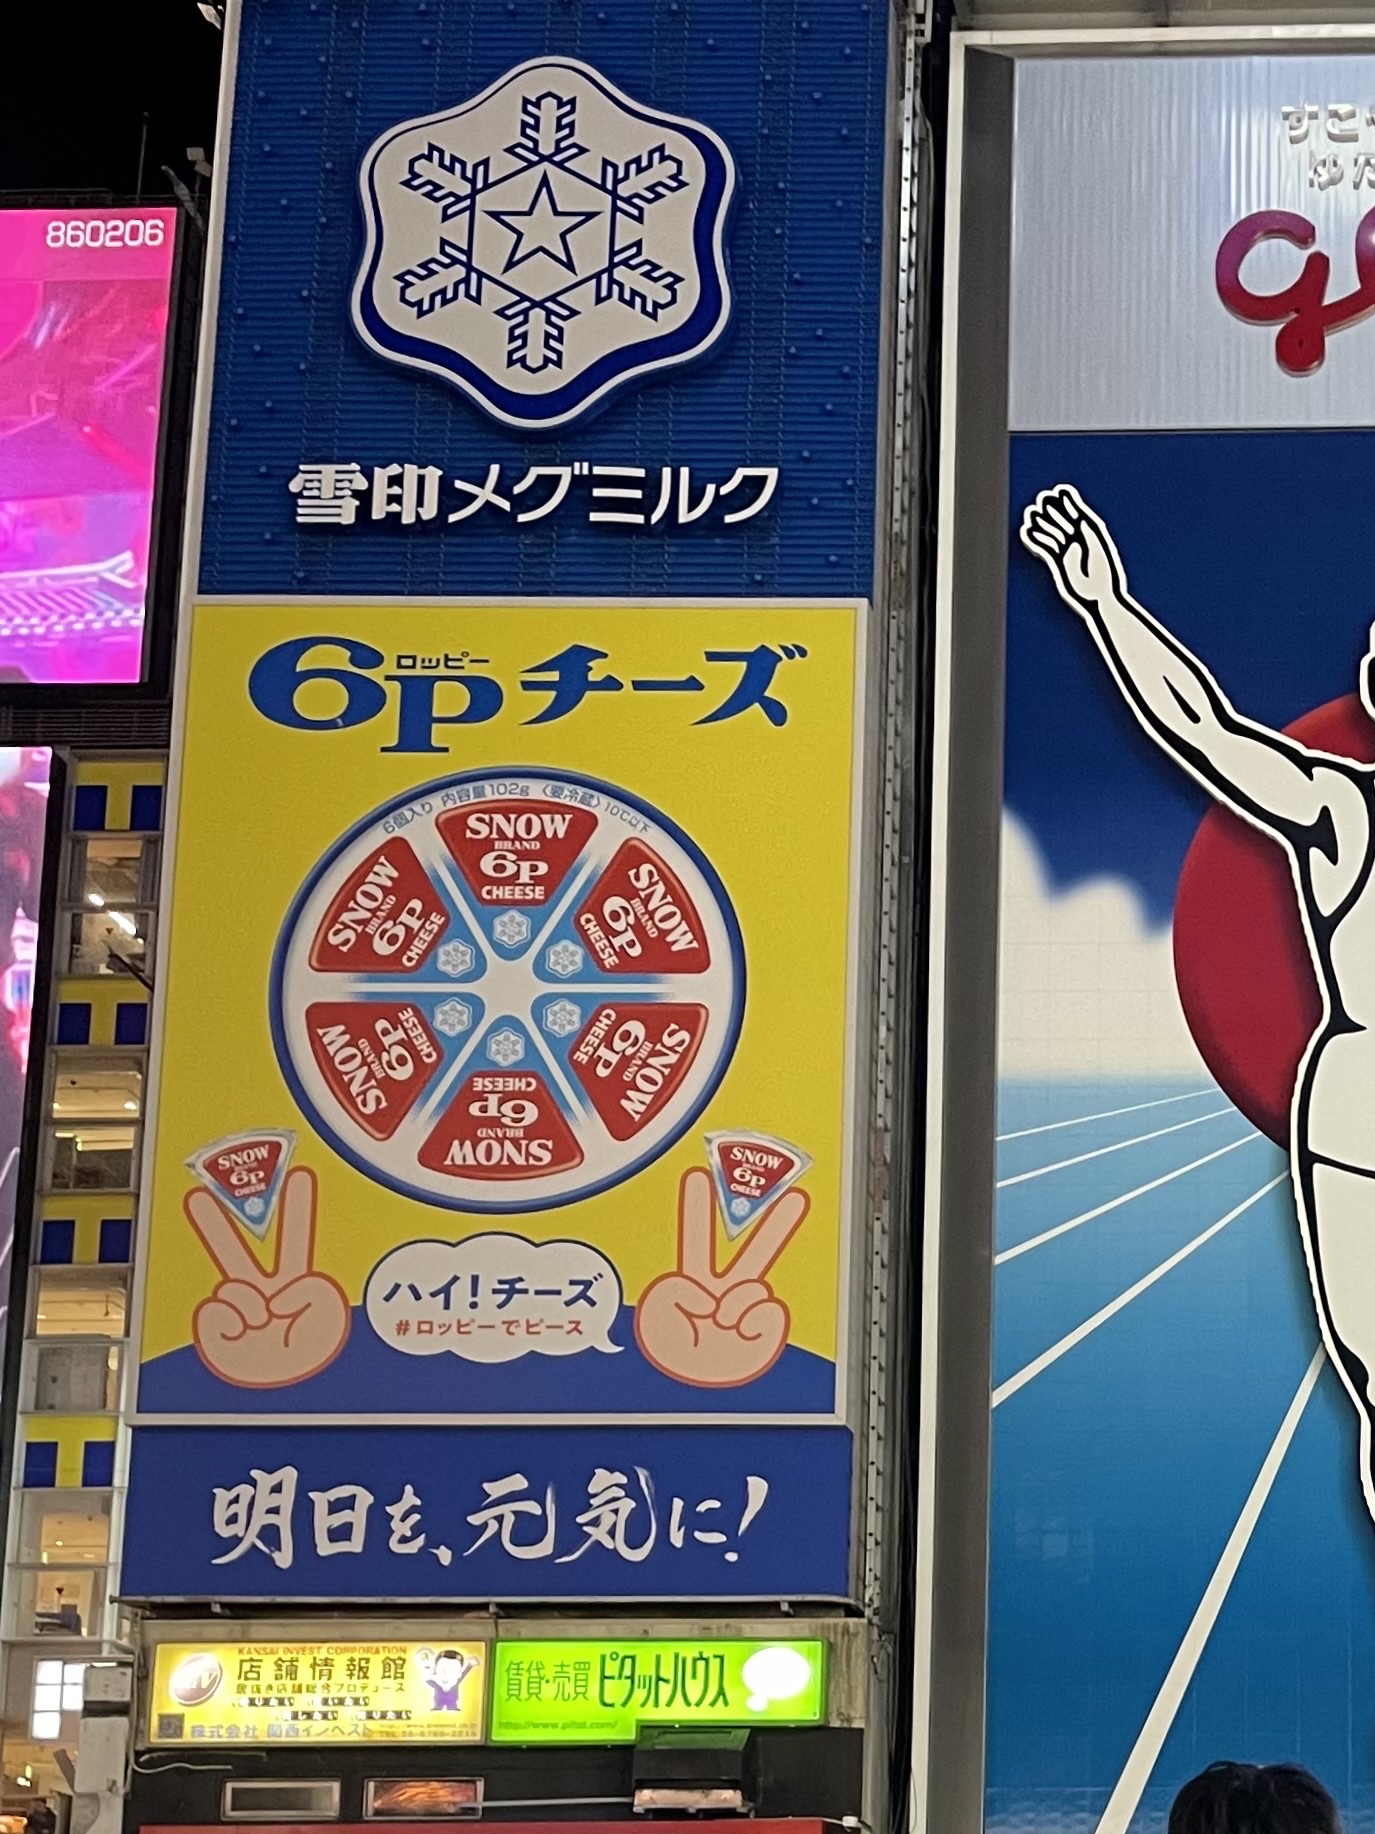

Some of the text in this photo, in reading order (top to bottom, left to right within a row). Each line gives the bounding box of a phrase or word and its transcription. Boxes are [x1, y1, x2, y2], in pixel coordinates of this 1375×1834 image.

[45, 219, 164, 248] 860206
[288, 462, 779, 526] 雪印メグミルク
[397, 652, 490, 669] ロッピー
[465, 813, 573, 839] SNOW
[494, 840, 541, 851] BRAND
[327, 855, 400, 953] SNOW
[481, 886, 545, 900] CHEESE
[628, 862, 699, 953] SNOW
[366, 894, 396, 936] BRAND
[630, 898, 658, 938] BRAND
[402, 911, 445, 968] CHEESE
[579, 912, 619, 970] CHEESE
[398, 1007, 438, 1064] CHEESE
[573, 1008, 616, 1064] CHEESE
[316, 1023, 388, 1116] SNOW
[473, 1077, 537, 1091] CHEESE
[620, 1023, 691, 1122] SNOW
[443, 1138, 553, 1166] SNOW
[395, 1318, 583, 1336] #ロッピーでピース
[237, 1656, 406, 1681] 店舗情報館
[238, 1646, 407, 1655] KANSAI INVEST CORPORATION
[600, 1651, 729, 1708] ピタットハウス
